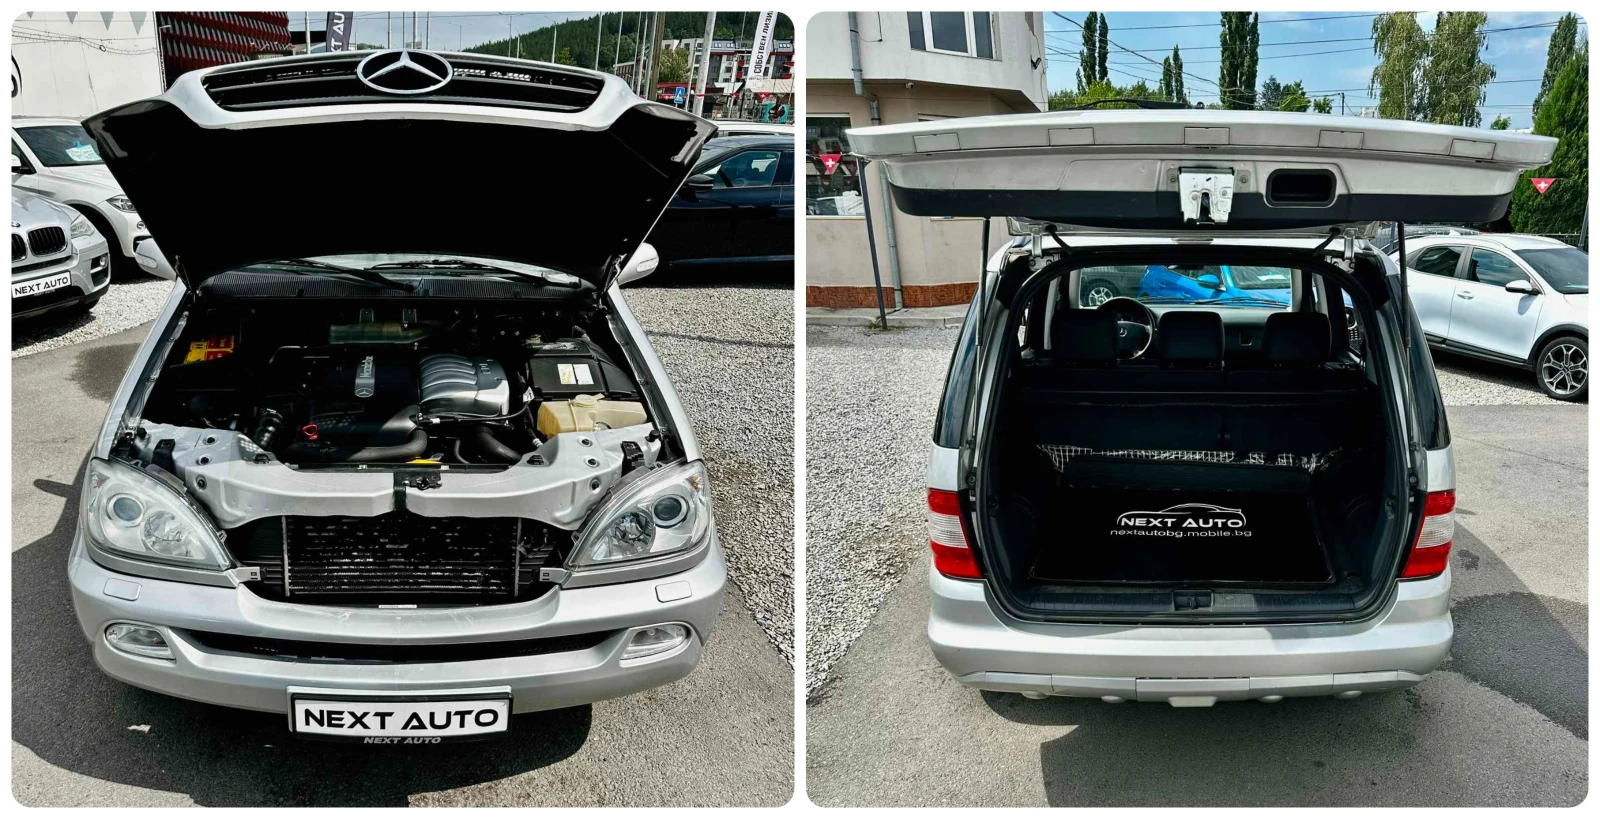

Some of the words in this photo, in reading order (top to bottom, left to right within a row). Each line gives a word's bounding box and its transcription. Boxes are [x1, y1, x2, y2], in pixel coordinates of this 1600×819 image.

[333, 11, 345, 36] AU
[754, 36, 767, 74] СОБСТВЕН
[763, 11, 774, 35] ЛИЗИ
[14, 283, 42, 295] NEXT
[43, 276, 69, 290] AUTO
[1121, 518, 1177, 527] NEXT
[1181, 518, 1243, 528] AUTO
[1110, 529, 1252, 538] nextautobg.mobile.bg
[304, 708, 395, 730] NEXT
[400, 708, 499, 731] AUTO
[363, 736, 401, 744] NEXT
[404, 736, 442, 744] AUTO
